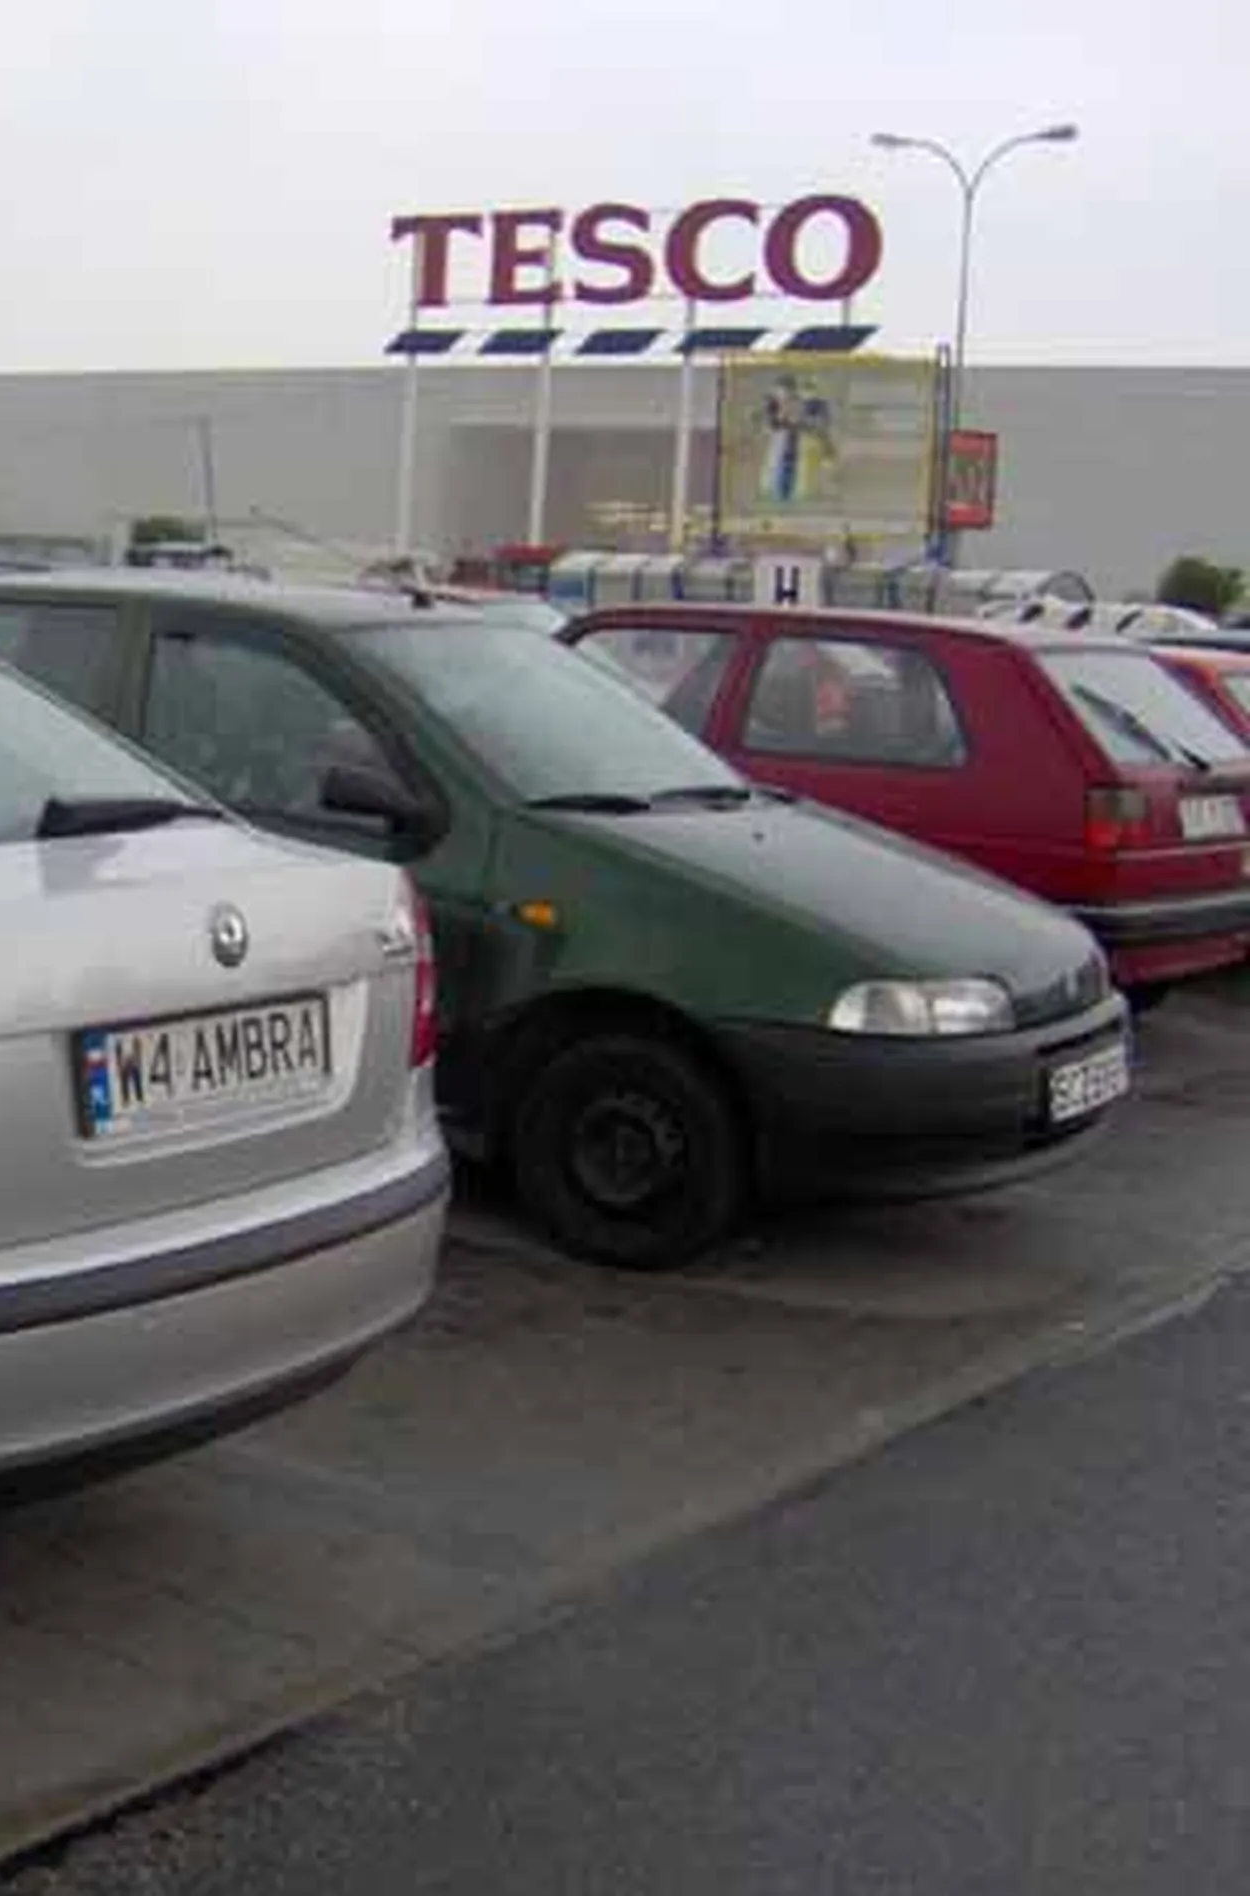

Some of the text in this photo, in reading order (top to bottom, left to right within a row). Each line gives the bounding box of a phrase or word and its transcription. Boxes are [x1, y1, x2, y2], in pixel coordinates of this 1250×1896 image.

[390, 193, 884, 308] TESCO
[774, 564, 801, 605] H
[115, 1008, 317, 1106] W4 AMBRA
